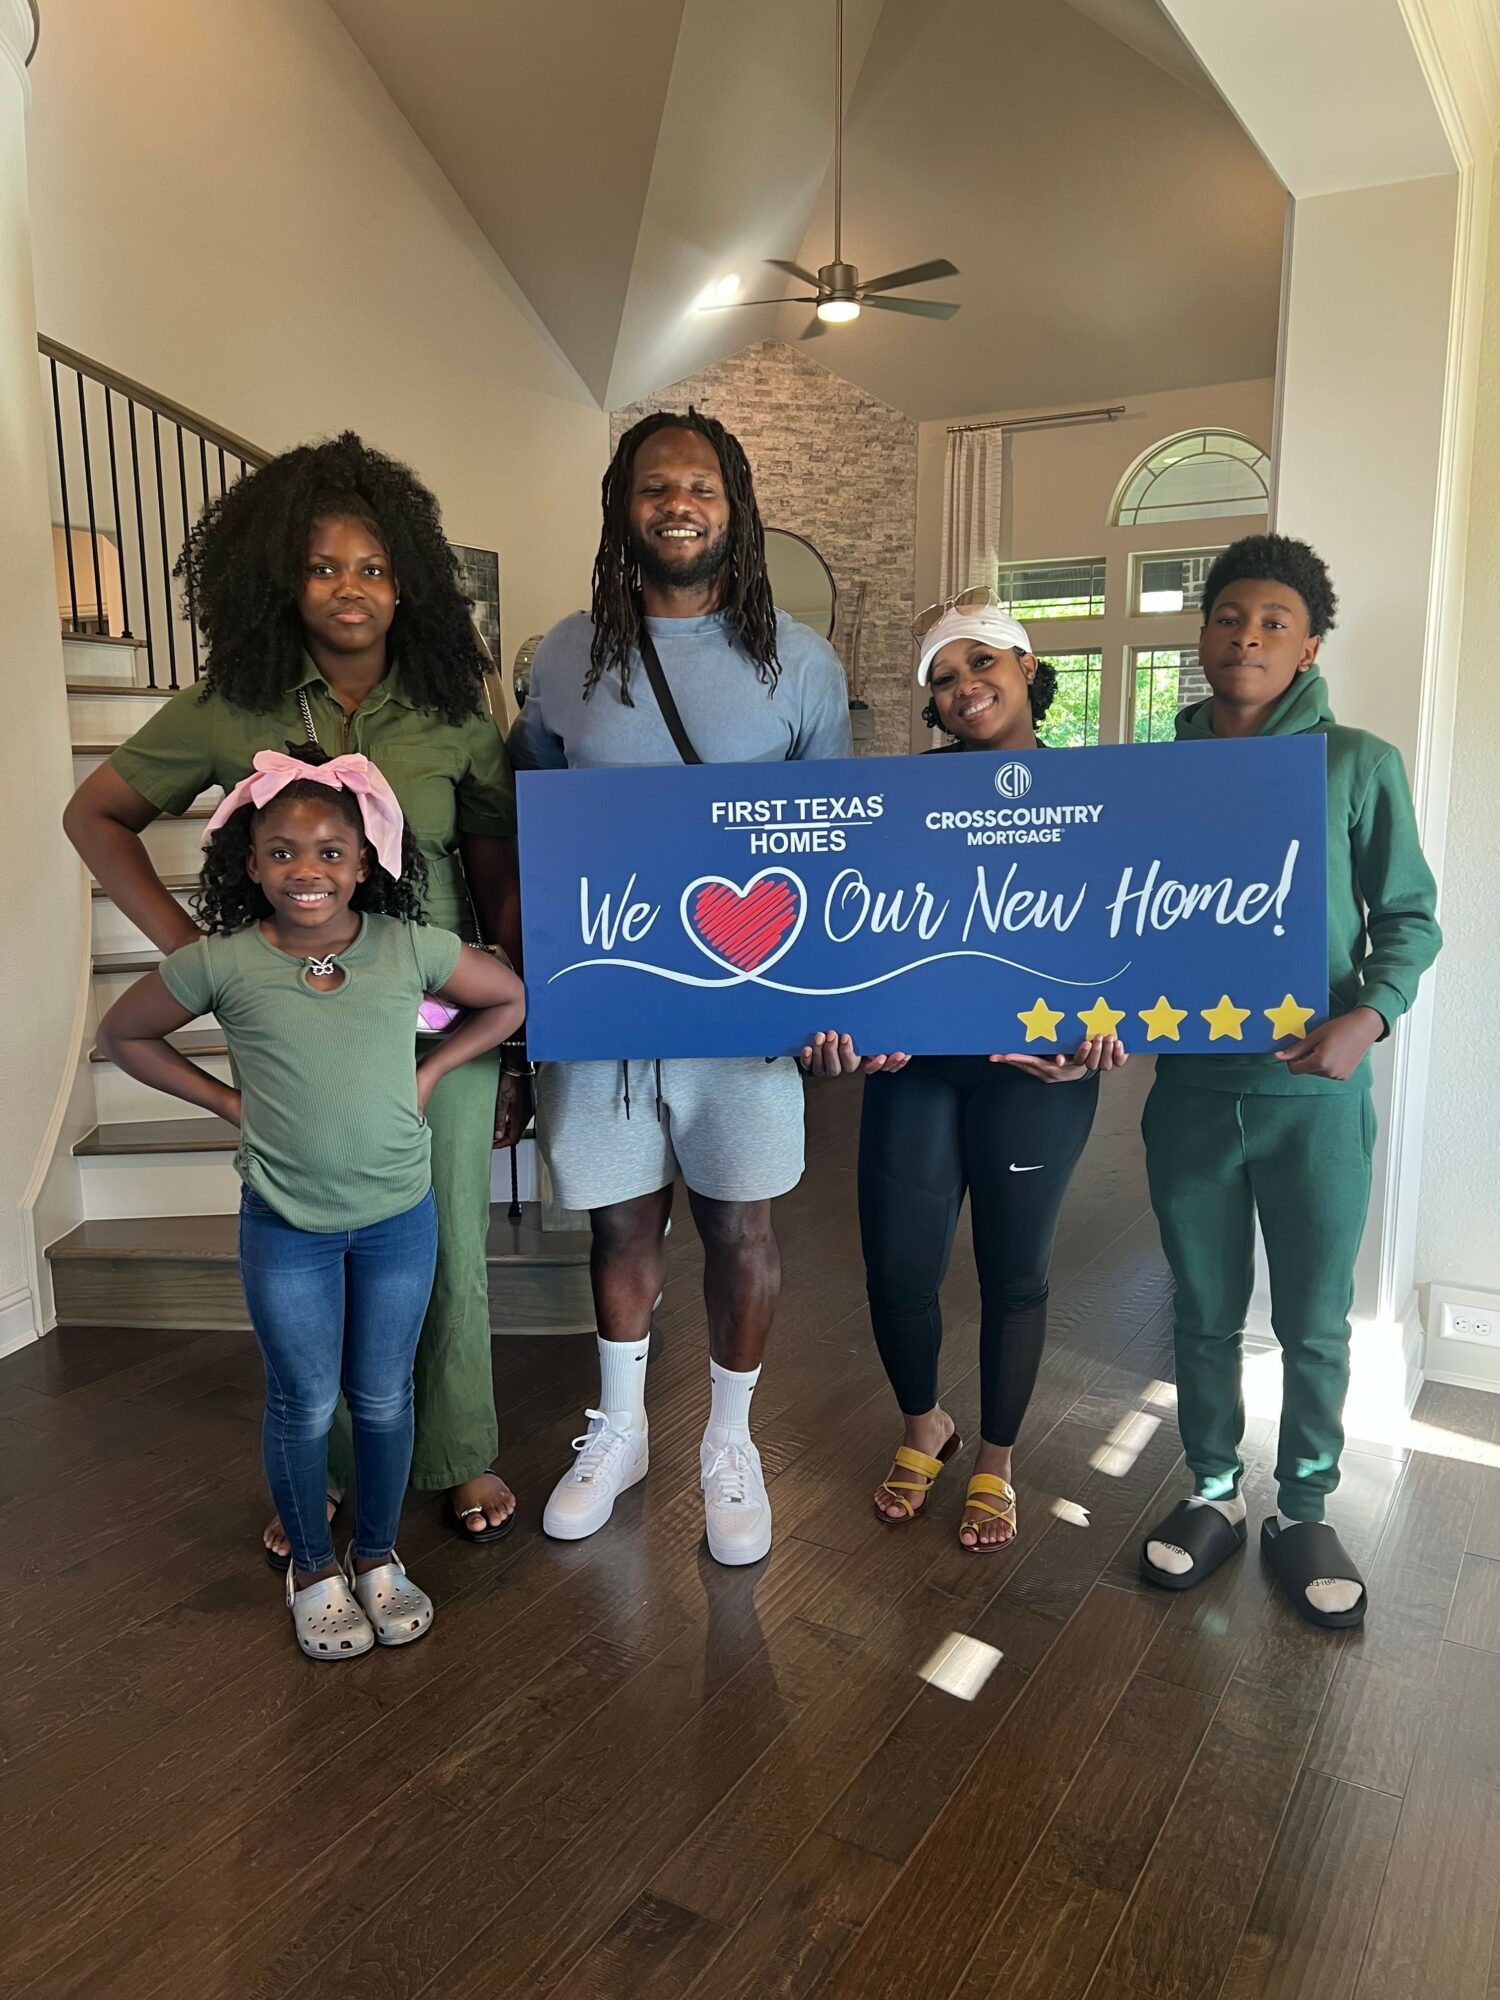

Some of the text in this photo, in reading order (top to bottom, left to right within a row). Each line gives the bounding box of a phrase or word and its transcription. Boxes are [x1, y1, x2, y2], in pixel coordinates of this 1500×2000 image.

[712, 796, 884, 823] FIRST TEXAS
[925, 804, 1104, 830] CROSSCOUNTRY
[750, 829, 847, 854] HOMES
[967, 828, 1062, 846] MORTGAGE
[580, 839, 1301, 951] We Our New Home!
